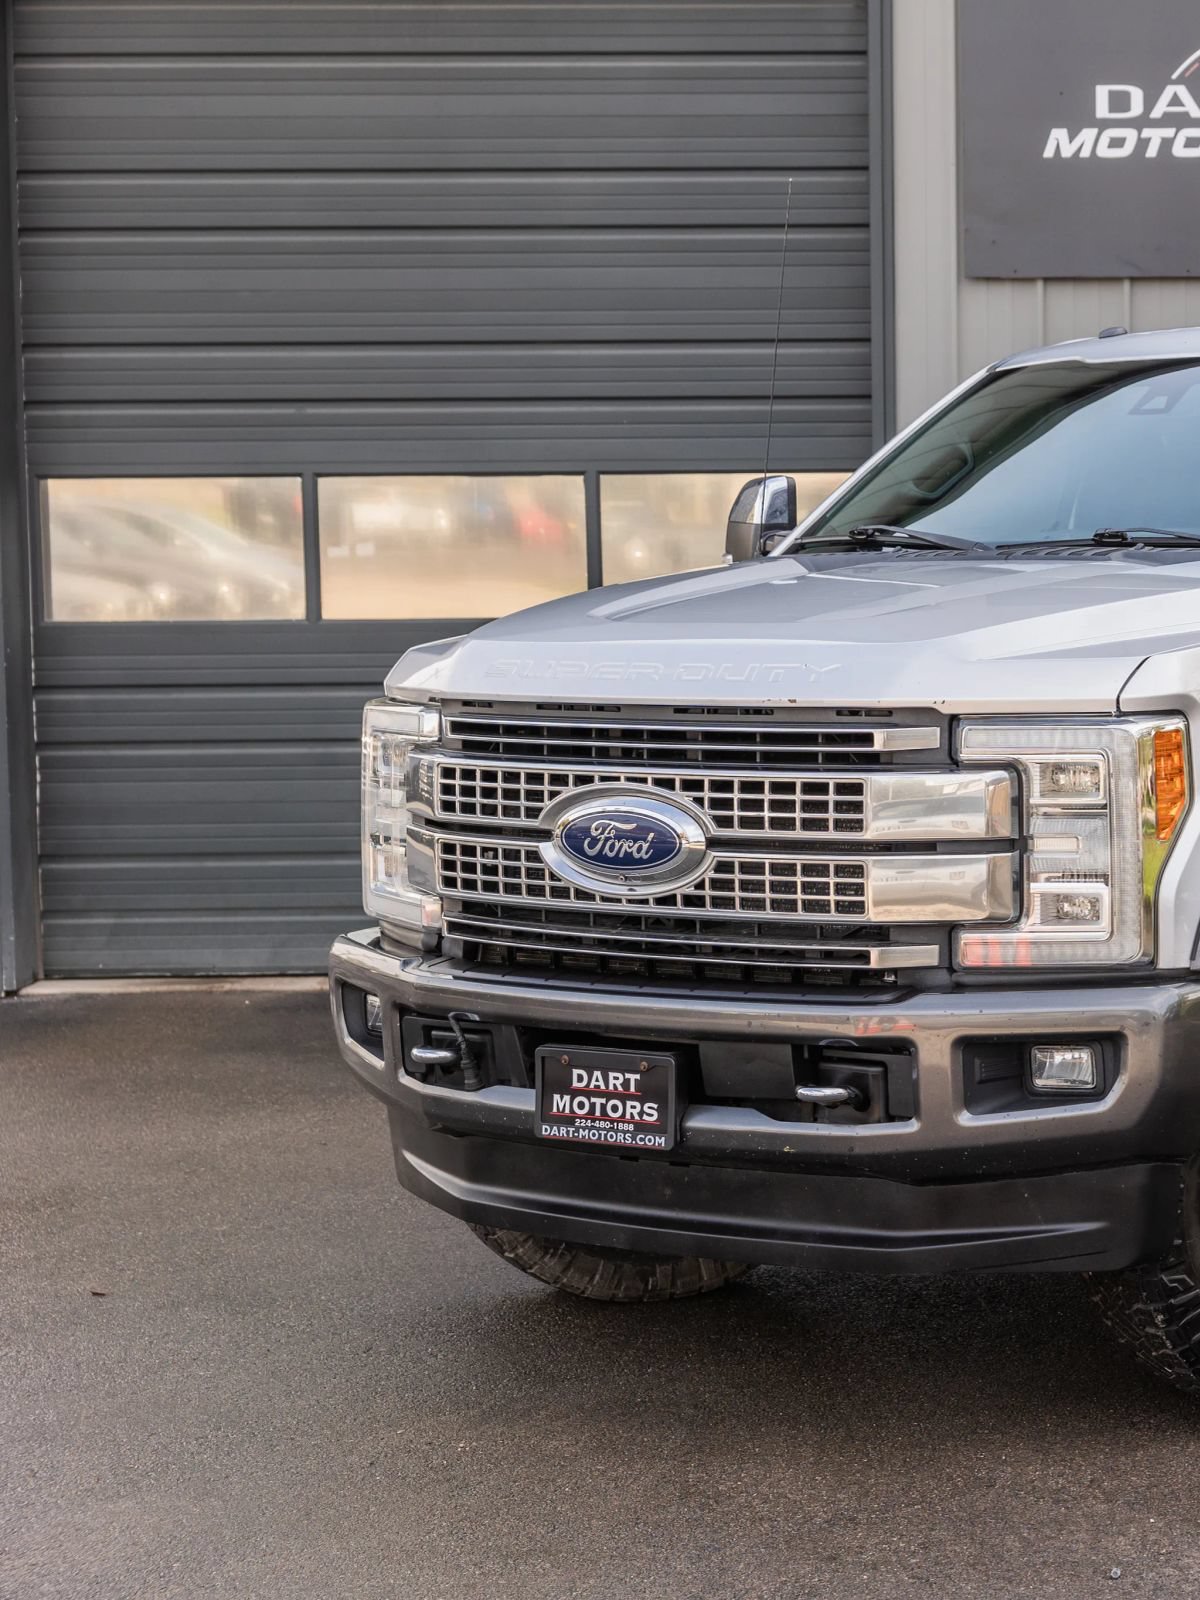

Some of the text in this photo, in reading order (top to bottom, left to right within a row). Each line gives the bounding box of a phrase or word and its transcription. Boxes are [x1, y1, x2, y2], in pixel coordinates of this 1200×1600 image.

[484, 658, 843, 683] SUPER DUTY
[583, 820, 655, 861] Ford
[571, 1068, 641, 1092] DART
[552, 1094, 659, 1122] MOTORS
[541, 1124, 666, 1147] DART-MOTORS.COM
[574, 1118, 634, 1131] 224-480-1888
